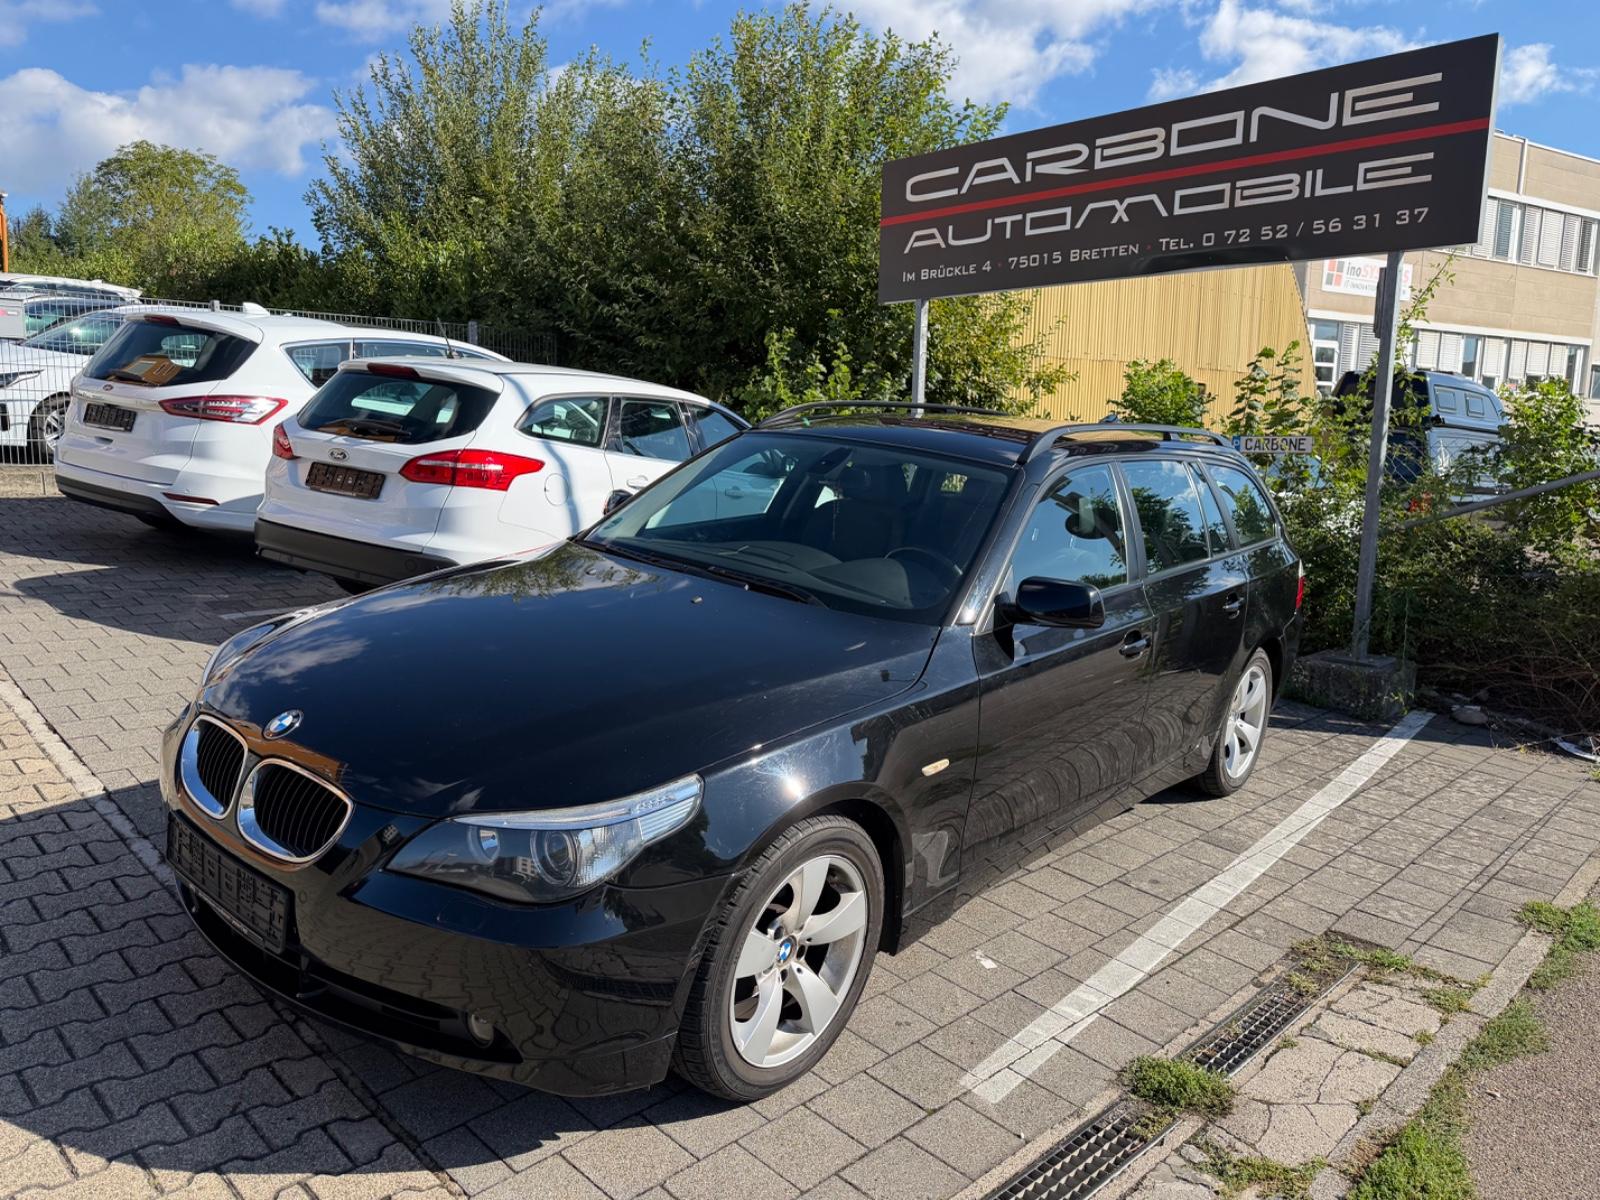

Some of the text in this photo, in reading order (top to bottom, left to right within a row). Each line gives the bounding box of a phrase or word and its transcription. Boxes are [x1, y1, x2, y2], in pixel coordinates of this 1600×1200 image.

[905, 72, 1443, 202] CARBONE
[903, 152, 1435, 254] AUTOMOBILE
[982, 260, 992, 273] 4
[1008, 251, 1063, 270] 75015
[1202, 232, 1215, 246] 0
[1224, 228, 1251, 244] 72
[1260, 224, 1288, 241] 52
[1312, 217, 1342, 235] 56
[1353, 213, 1381, 230] 31
[1396, 207, 1430, 226] 37
[1245, 438, 1306, 451] CARBONE
